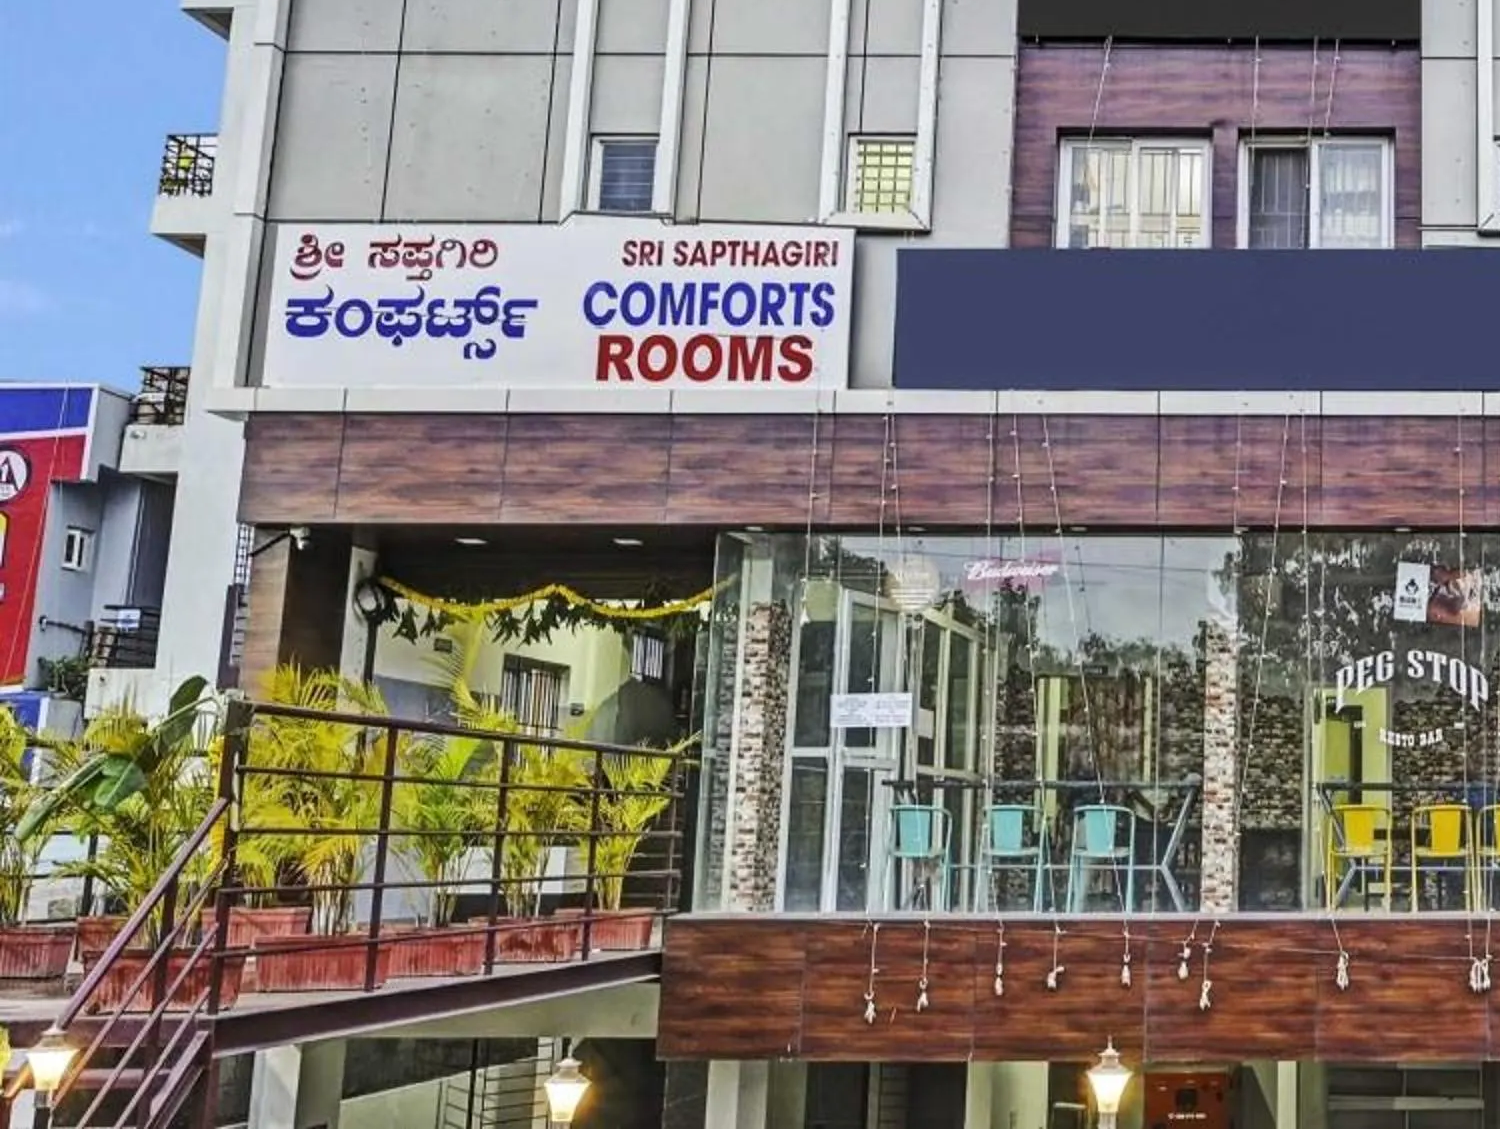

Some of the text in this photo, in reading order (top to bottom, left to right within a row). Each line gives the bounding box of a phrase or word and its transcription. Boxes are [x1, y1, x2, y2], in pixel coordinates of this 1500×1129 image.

[290, 233, 499, 282] ಶ್ರೀ ಸಪ್ತಗಿರಿ
[621, 240, 839, 268] SRI SAPTHAGIRI
[583, 281, 836, 327] COMFORTS
[596, 333, 814, 383] ROOMS
[1335, 649, 1489, 714] PEG STOP
